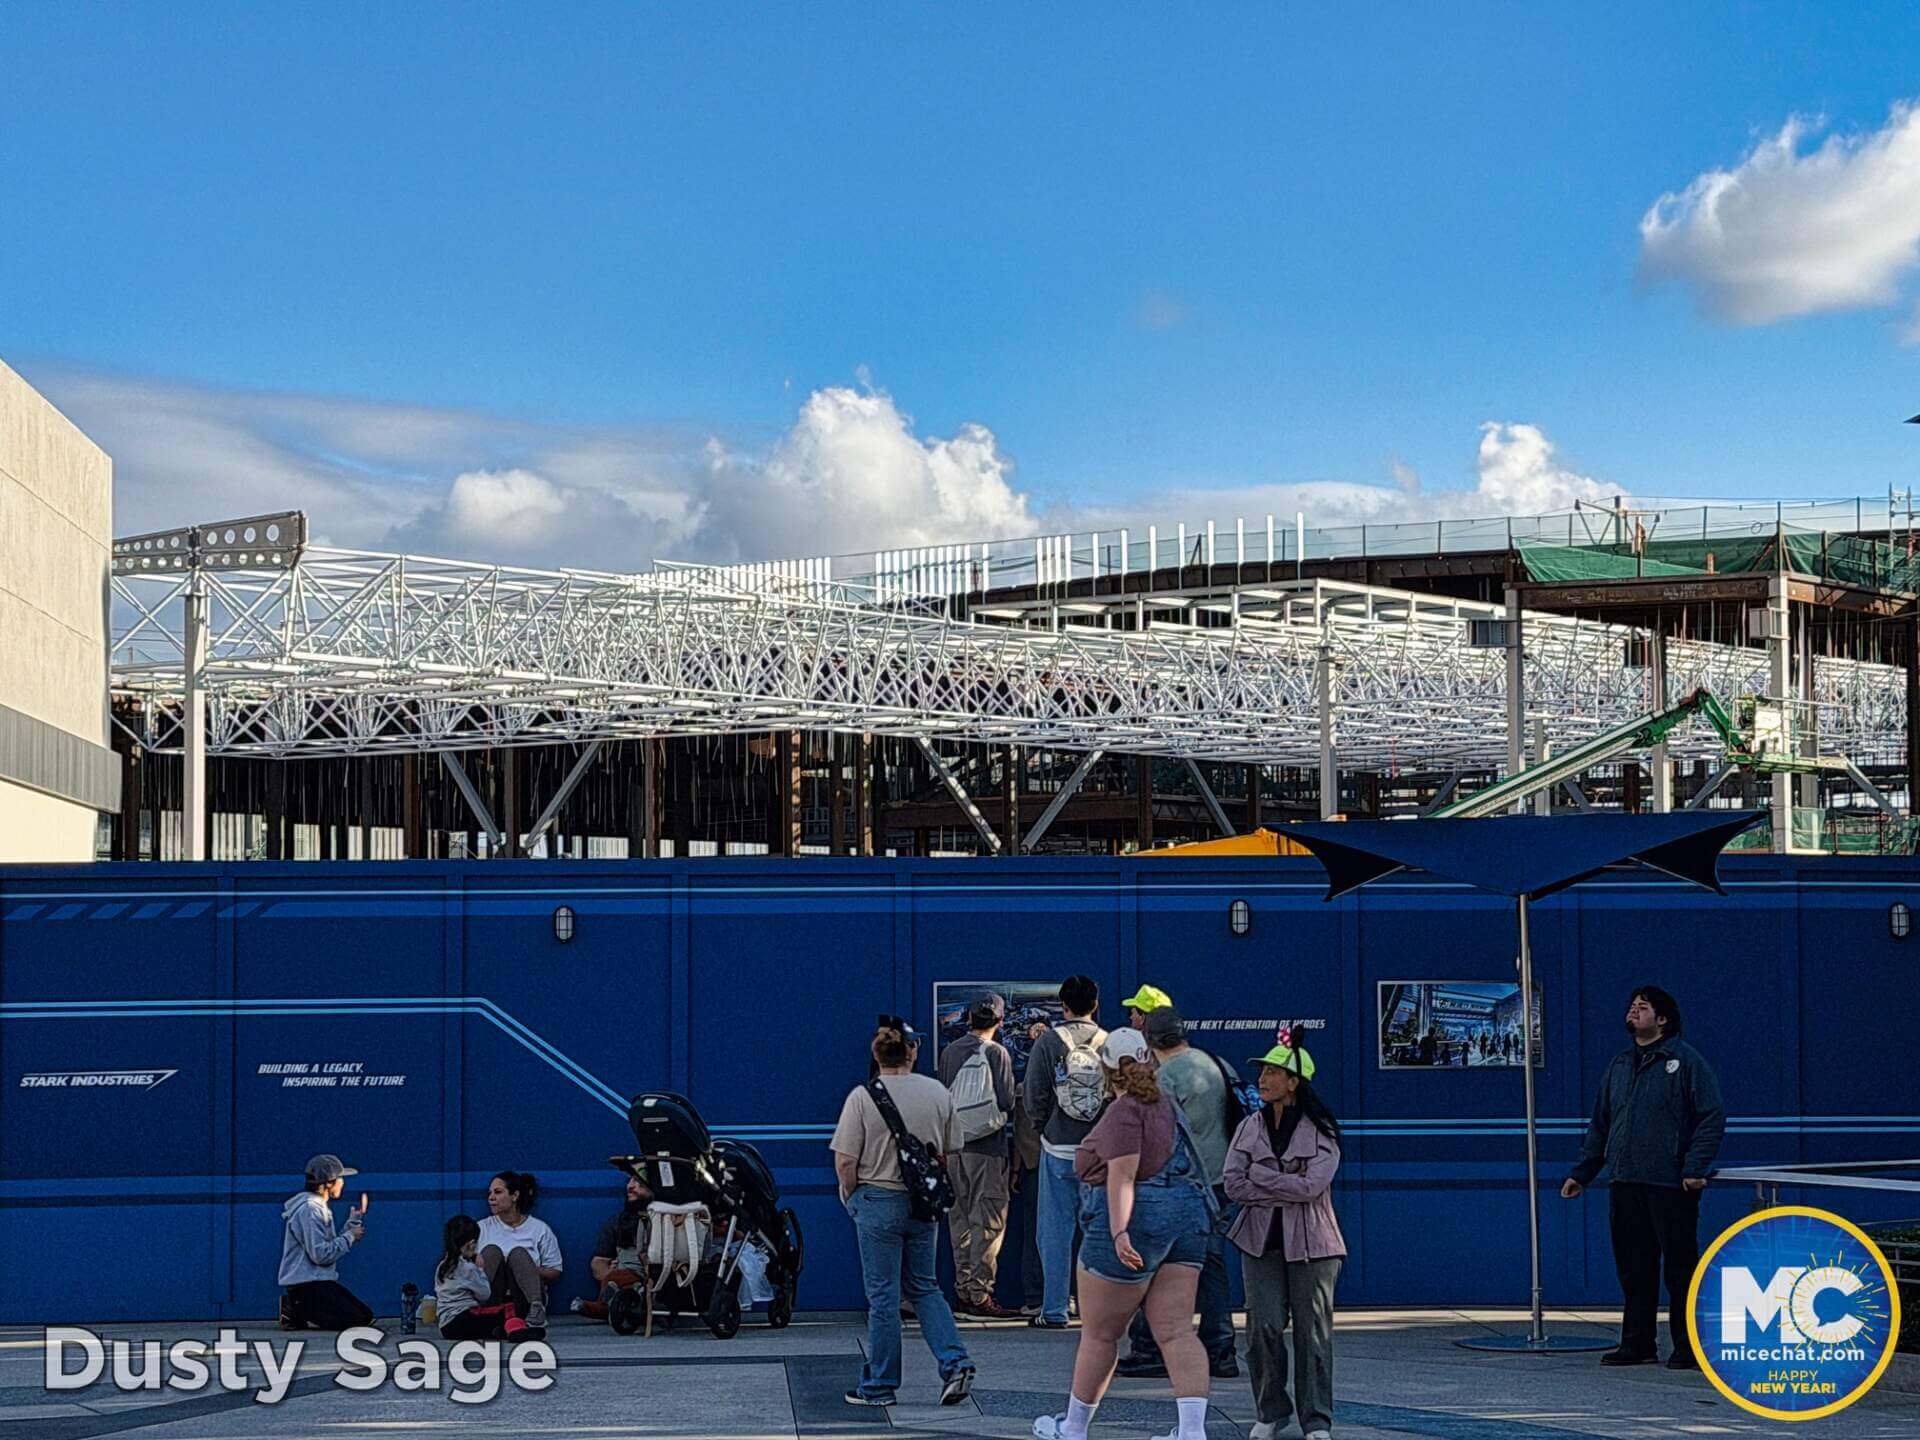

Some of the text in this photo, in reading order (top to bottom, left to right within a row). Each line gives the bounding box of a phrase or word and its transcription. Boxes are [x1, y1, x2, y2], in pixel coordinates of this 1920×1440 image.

[1182, 1020, 1199, 1031] THE
[1200, 1020, 1224, 1030] NEXT
[1225, 1020, 1277, 1030] GENERATION
[1279, 1020, 1290, 1030] OF
[258, 1064, 309, 1074] BUILDING
[310, 1063, 319, 1073] A
[20, 1075, 154, 1087] STARK INDUSTRIES
[282, 1076, 405, 1087] INSPIRING THE FUTURE
